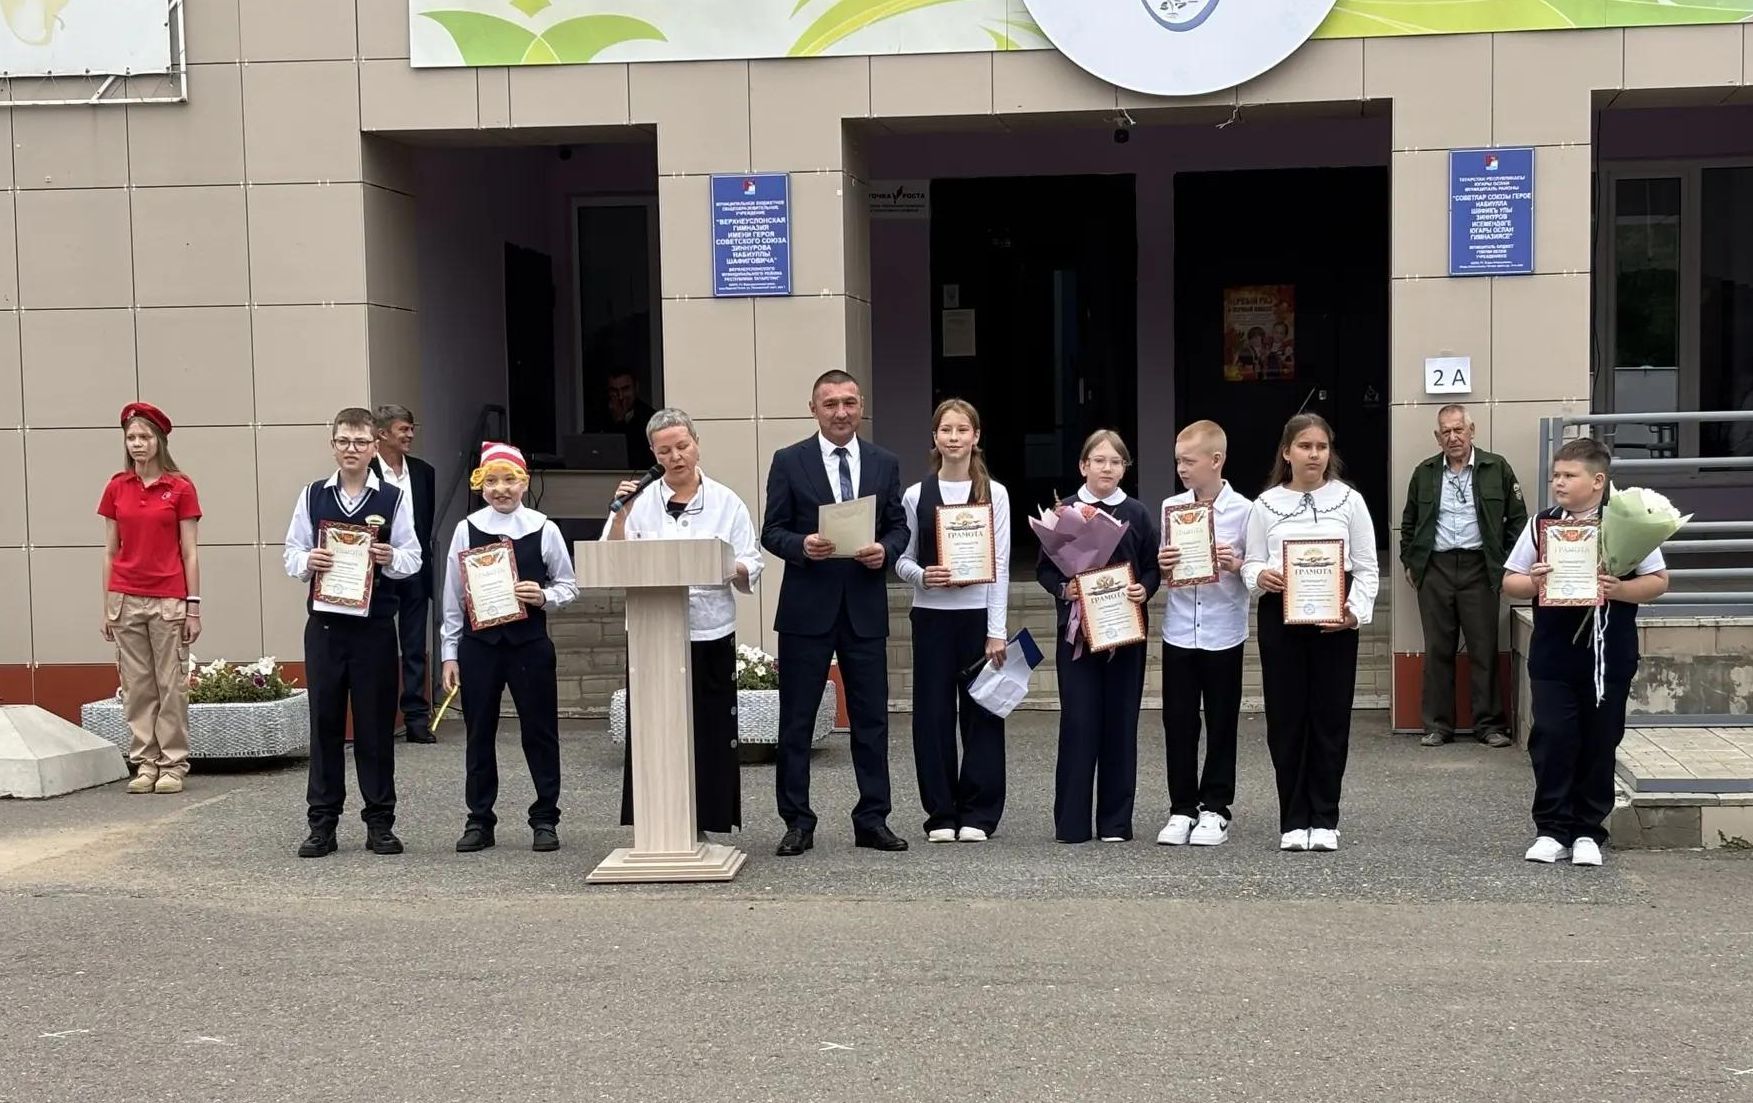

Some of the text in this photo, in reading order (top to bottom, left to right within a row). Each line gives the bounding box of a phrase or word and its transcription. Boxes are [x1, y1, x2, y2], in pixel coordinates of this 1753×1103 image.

[731, 244, 772, 252] ЗИННУРОВА
[1433, 368, 1467, 386] 2 А
[948, 530, 984, 539] ГРАМОТА
[1090, 591, 1126, 604] ГРАМОТА
